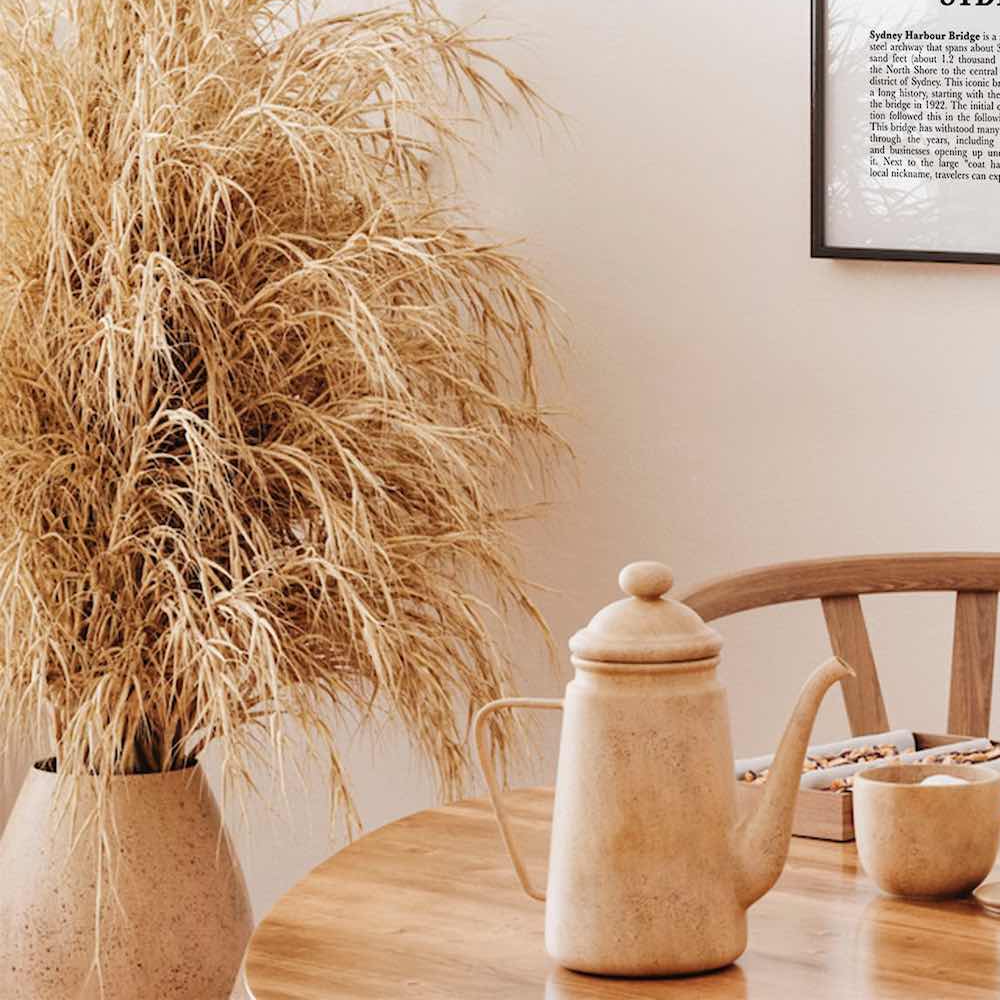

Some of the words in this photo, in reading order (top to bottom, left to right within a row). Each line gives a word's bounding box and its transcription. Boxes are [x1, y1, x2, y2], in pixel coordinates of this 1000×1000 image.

[868, 30, 903, 42] Sydney
[904, 31, 946, 40] Harbour
[948, 31, 981, 43] Bridge
[982, 32, 989, 40] is
[869, 41, 887, 51] steel
[889, 42, 924, 53] archway
[926, 42, 942, 51] that
[944, 45, 967, 54] spans
[969, 43, 993, 52] about
[868, 53, 888, 62] sand
[892, 53, 907, 63] feet
[942, 54, 954, 63] 1.2
[958, 54, 996, 64] thousand
[868, 76, 897, 85] district
[899, 76, 908, 86] of
[910, 76, 941, 88] Sydney.
[945, 77, 963, 86] This
[964, 78, 989, 87] iconic
[869, 99, 882, 108] the
[884, 99, 911, 111] bridge
[913, 101, 922, 109] in
[952, 100, 967, 109] The
[970, 100, 994, 110] initial
[870, 122, 888, 131] This
[890, 122, 916, 134] bridge
[918, 123, 933, 132] has
[934, 123, 974, 133] withstood
[976, 127, 1000, 136] many
[868, 144, 885, 154] and
[889, 145, 930, 155] businesses
[933, 147, 967, 158] opening
[971, 150, 983, 159] up
[869, 168, 888, 178] local
[891, 169, 932, 180] nickname,
[934, 170, 969, 180] travelers
